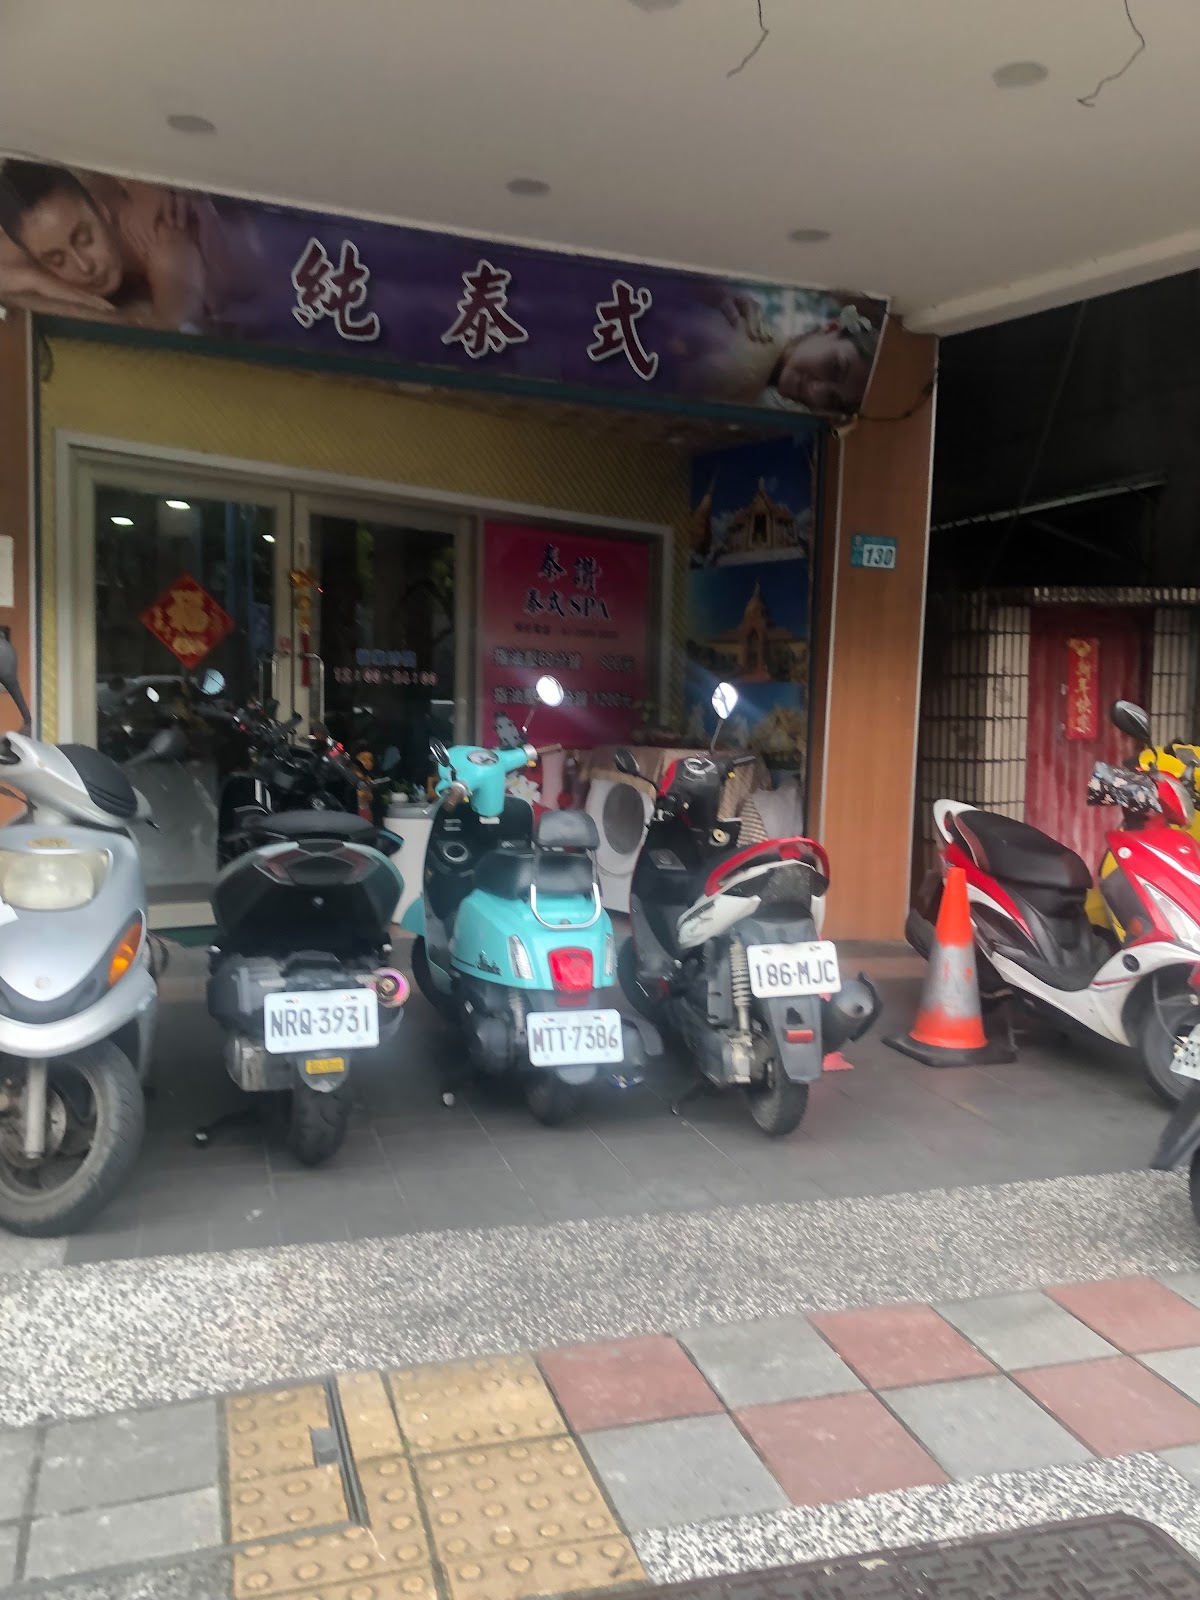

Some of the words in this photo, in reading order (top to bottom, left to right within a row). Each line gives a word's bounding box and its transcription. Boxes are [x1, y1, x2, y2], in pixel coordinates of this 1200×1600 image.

[291, 237, 660, 381] 純泰式
[865, 547, 894, 566] 130
[755, 959, 837, 988] 186-MJC
[270, 1004, 370, 1038] NRQ-3931
[532, 1024, 619, 1053] MTT-7386
